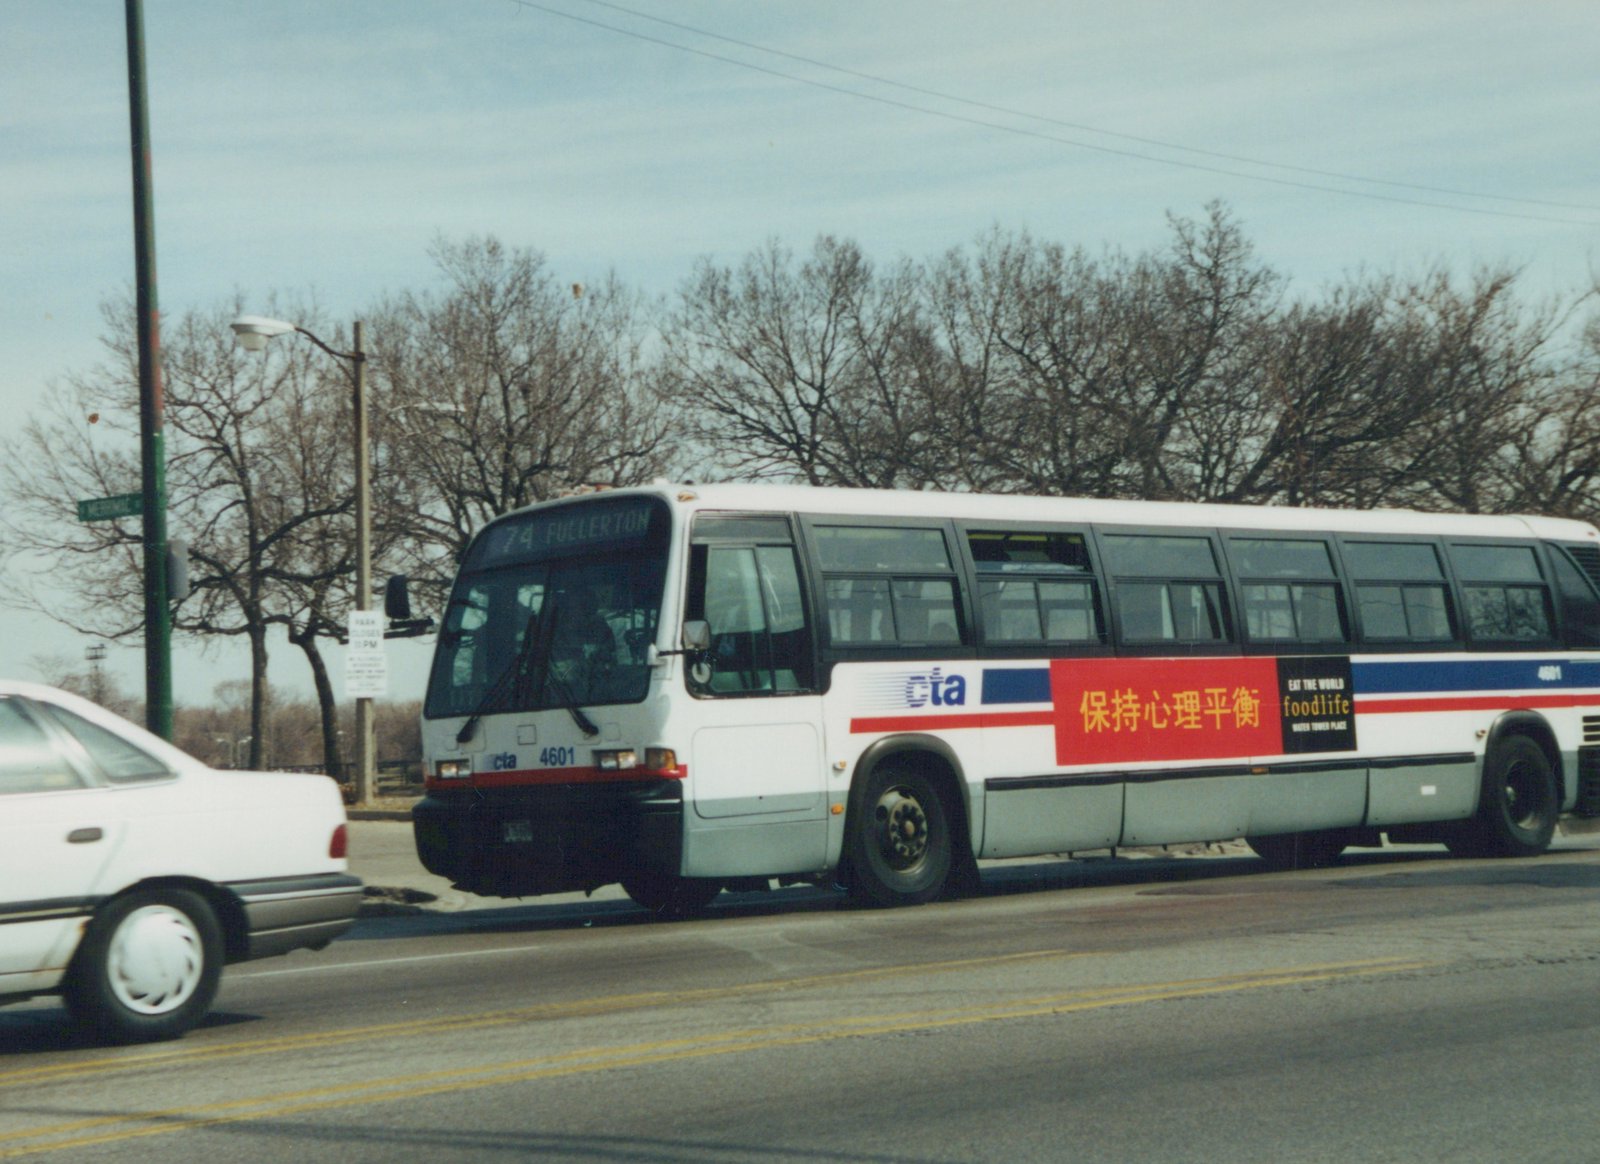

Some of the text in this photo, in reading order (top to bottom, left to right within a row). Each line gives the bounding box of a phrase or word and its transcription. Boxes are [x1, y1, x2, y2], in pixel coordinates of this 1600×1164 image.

[503, 509, 650, 553] 74 FULLERTON
[904, 666, 967, 708] cta
[1287, 677, 1345, 692] EAT THE WORLD
[1079, 686, 1261, 734] 保持心理平衡
[1283, 693, 1350, 717] foodlife
[1330, 720, 1348, 731] PLACE
[493, 751, 517, 770] cta
[539, 746, 576, 767] 4601
